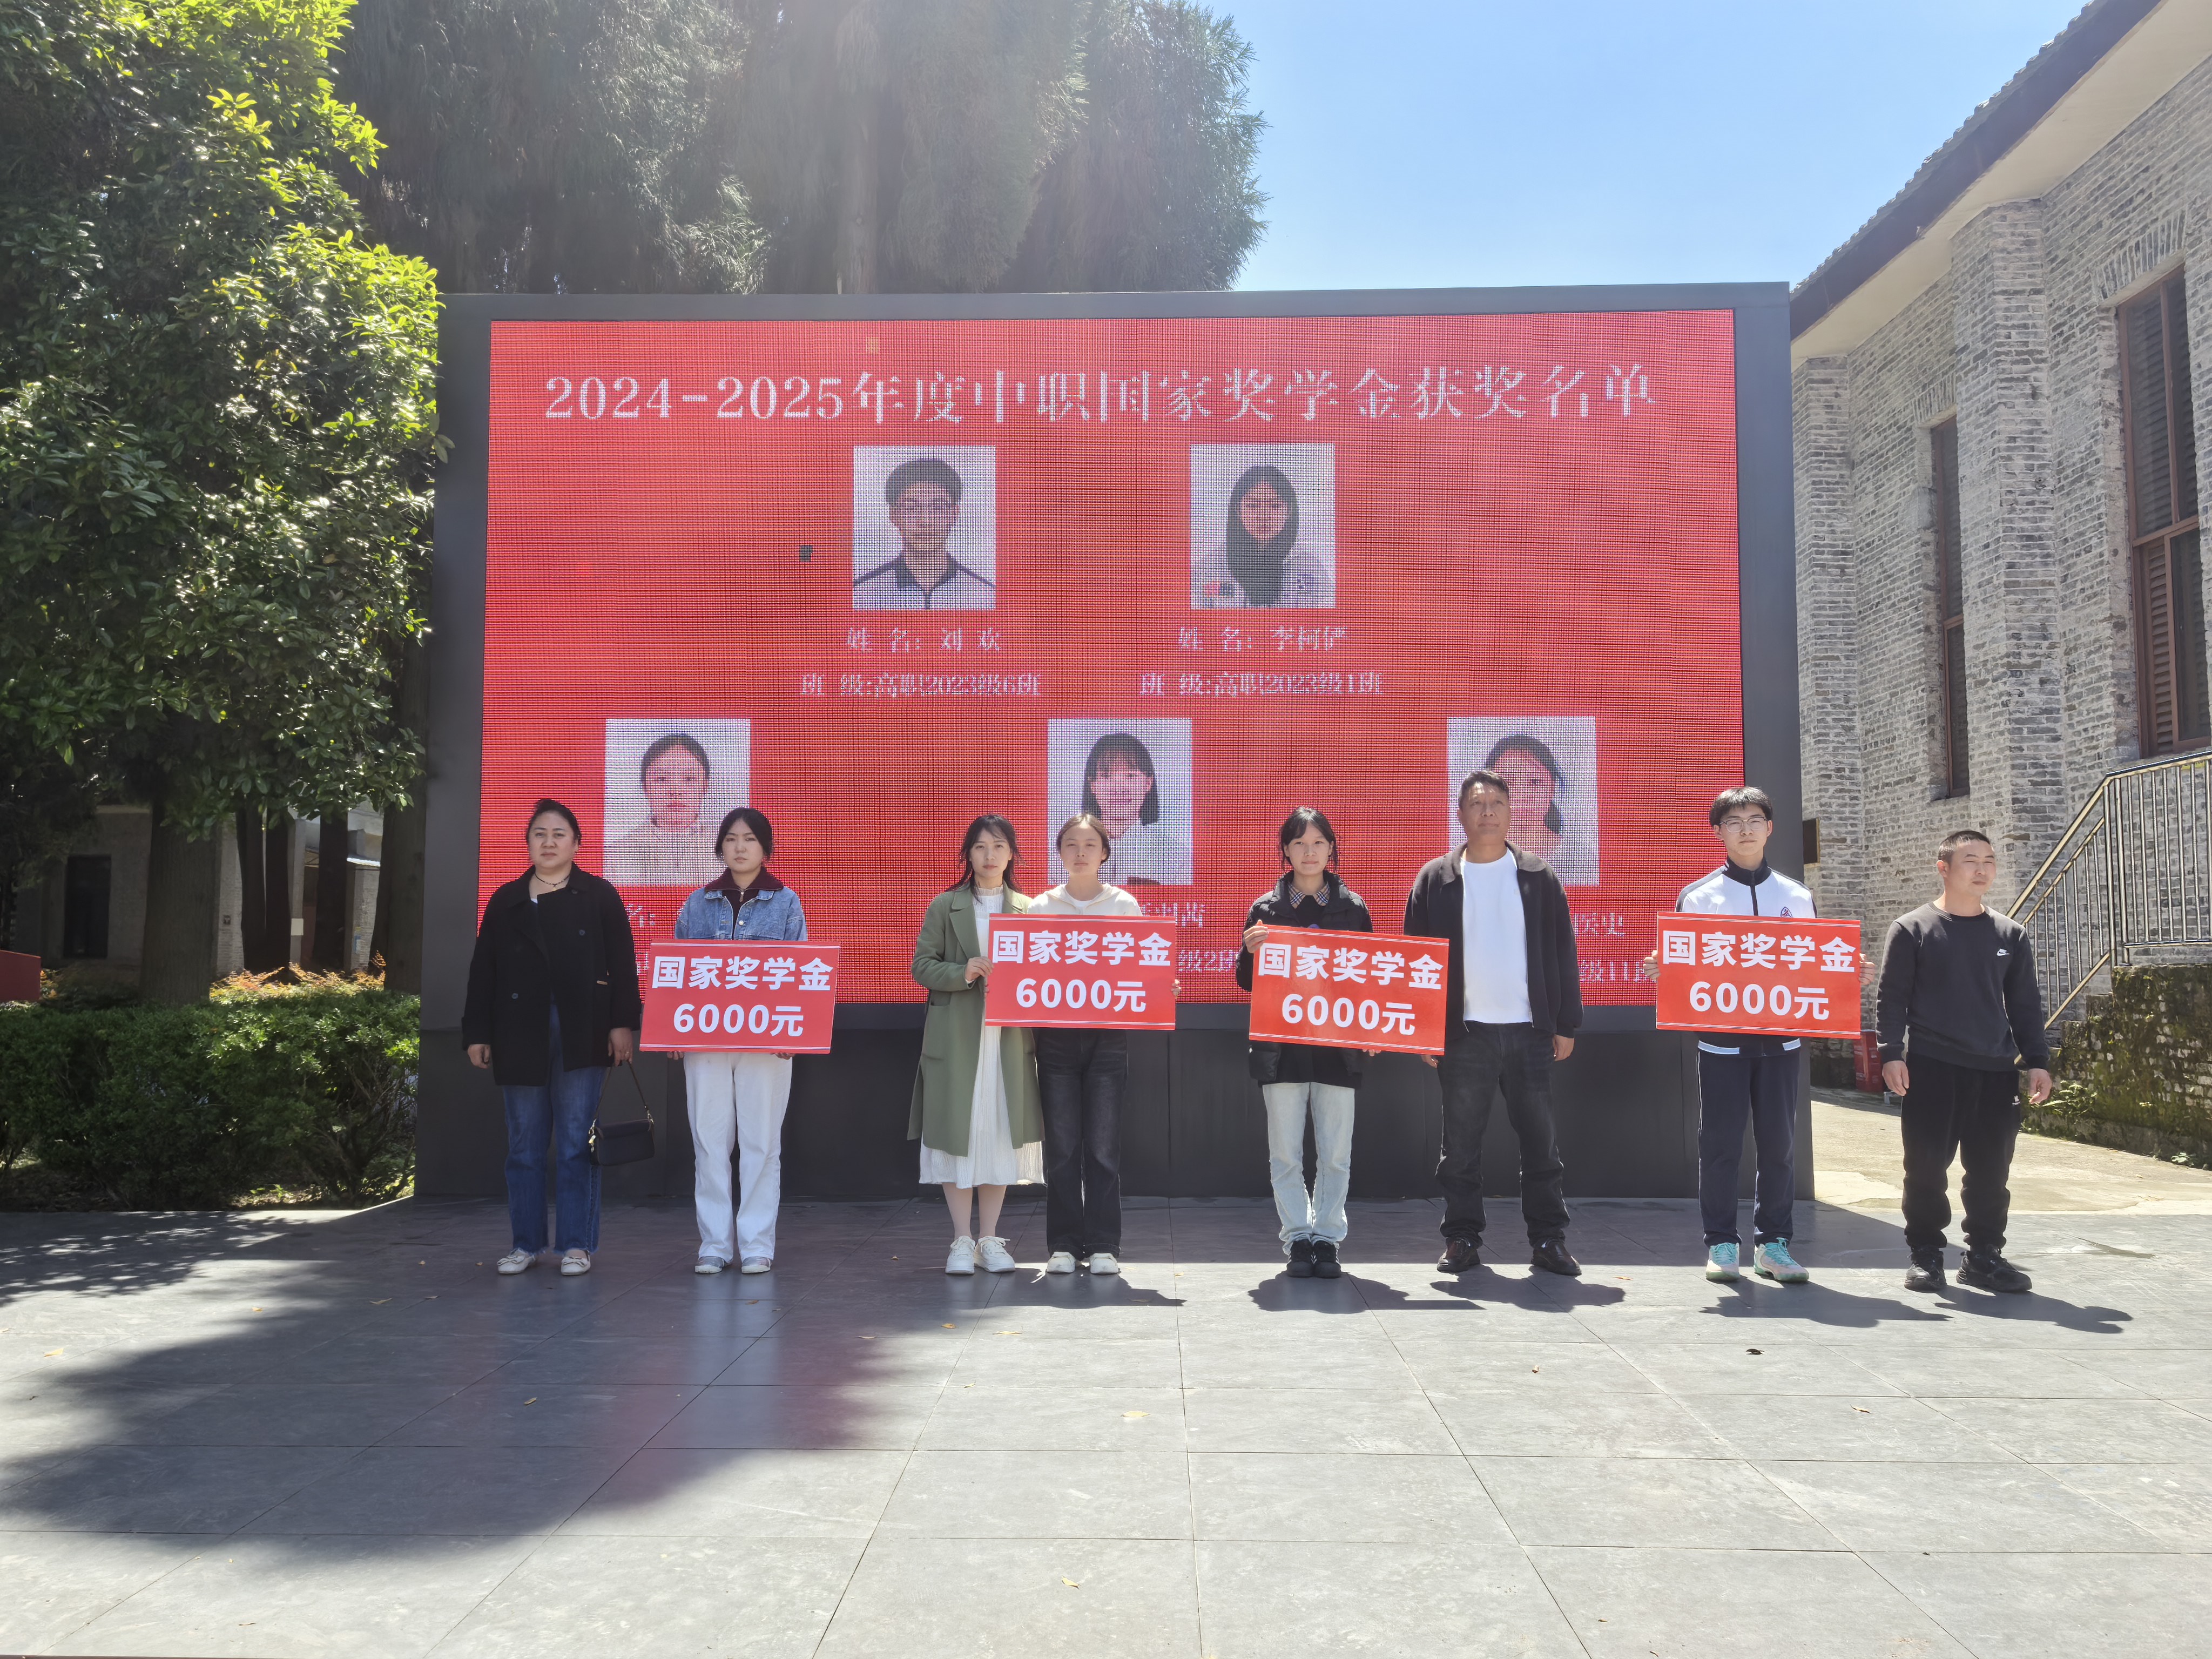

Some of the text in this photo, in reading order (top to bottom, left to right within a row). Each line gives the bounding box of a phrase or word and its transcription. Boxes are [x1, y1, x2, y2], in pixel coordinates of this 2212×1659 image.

[545, 364, 1656, 423] 2024-2025年度中职国家奖学金获奖名单
[993, 930, 1172, 967] 国家奖学金
[1258, 943, 1444, 990] 国家奖学金
[1663, 930, 1856, 973] 国家奖学金
[652, 955, 833, 991] 国家奖学金
[1016, 978, 1147, 1013] 6000元
[1282, 993, 1416, 1036] 6000元
[1689, 981, 1830, 1020] 6000元
[673, 1003, 804, 1037] 6000元
